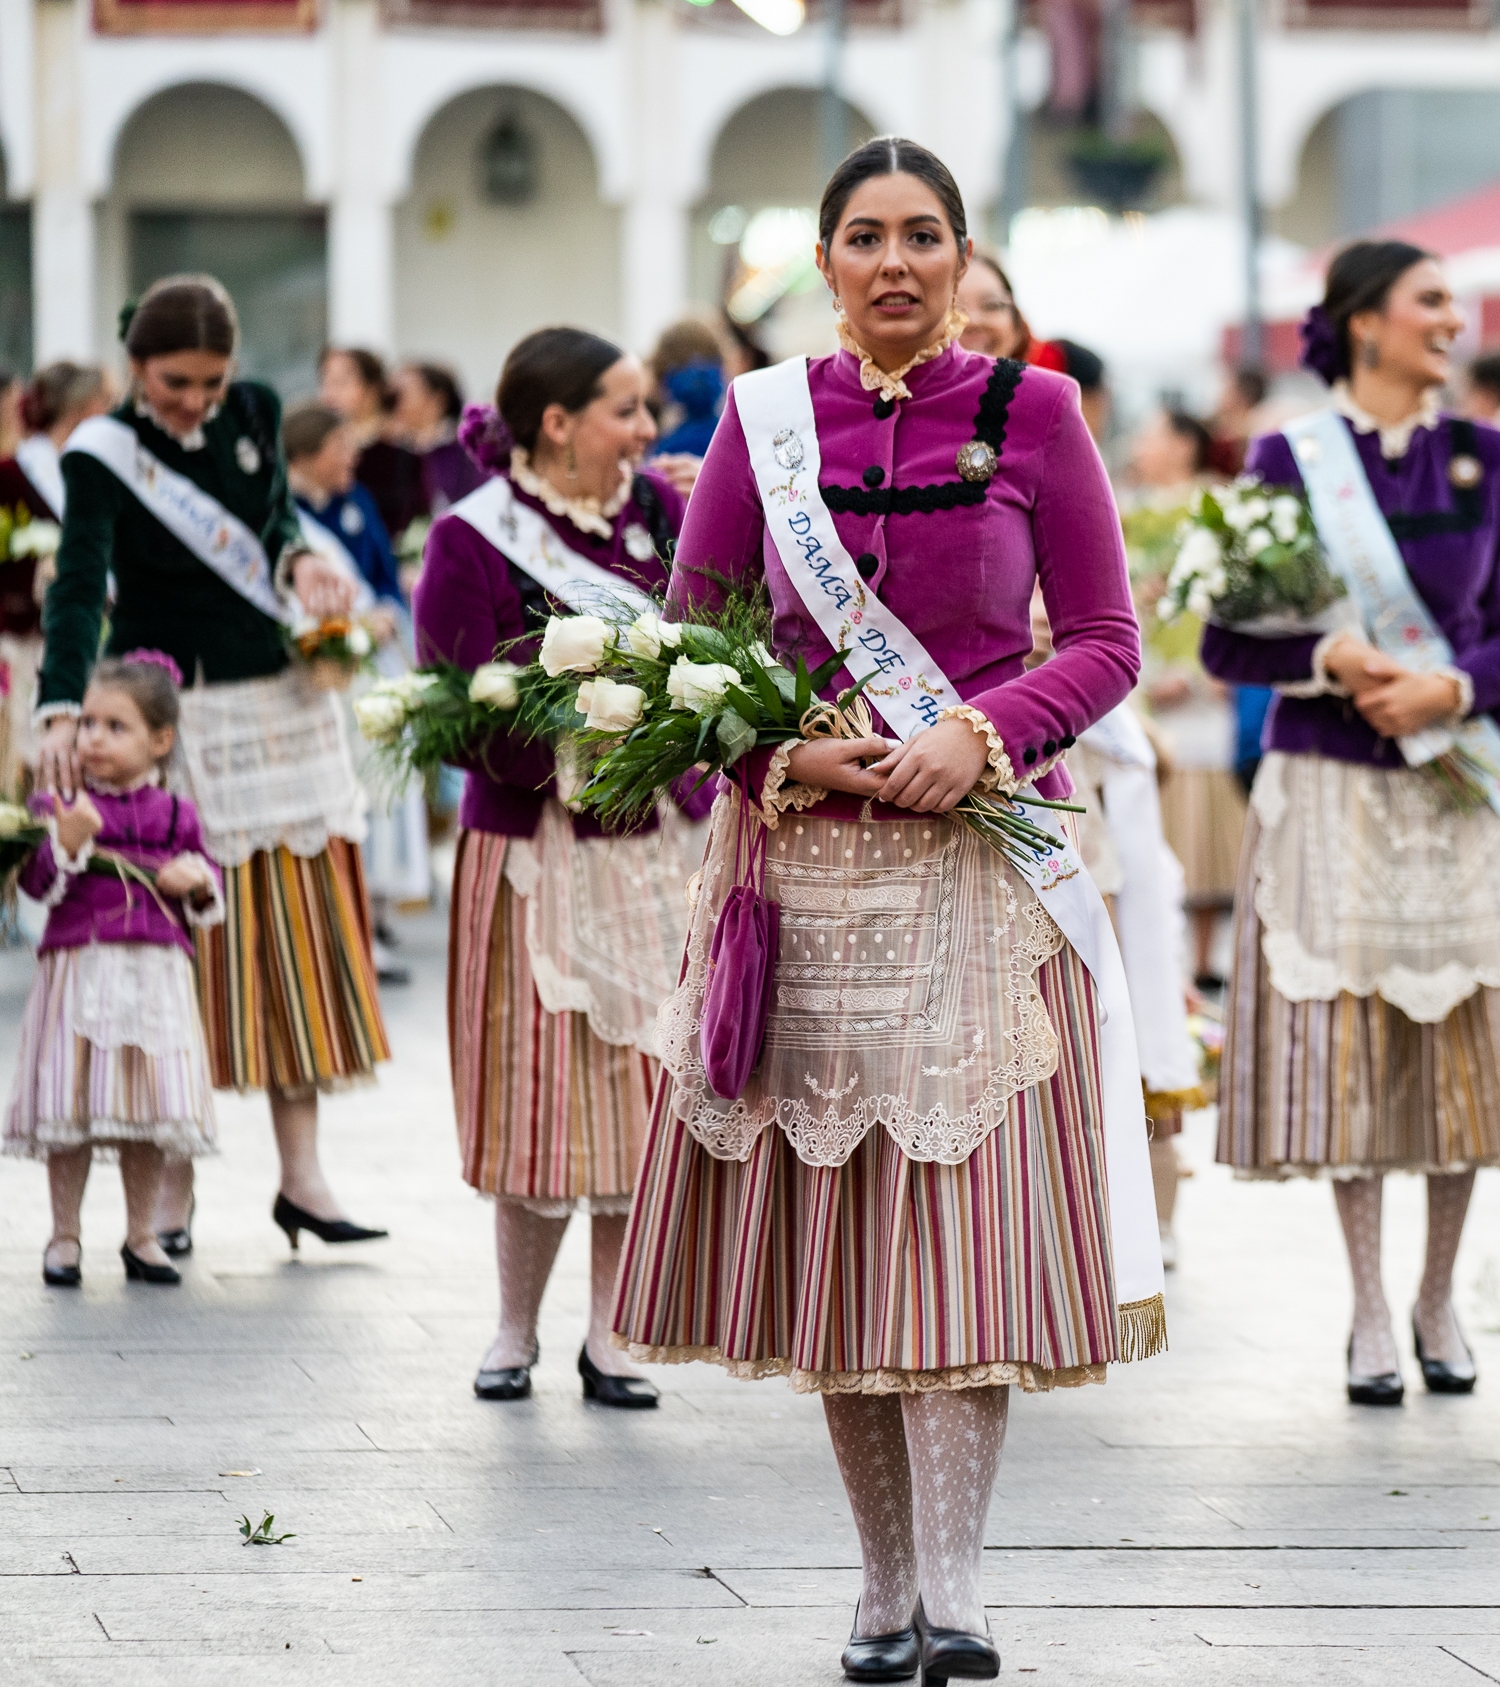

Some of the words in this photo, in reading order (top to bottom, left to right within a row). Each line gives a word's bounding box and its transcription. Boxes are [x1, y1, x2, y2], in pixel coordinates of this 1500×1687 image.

[788, 511, 852, 611] DAMA
[858, 628, 905, 675] DE
[910, 696, 939, 727] H
